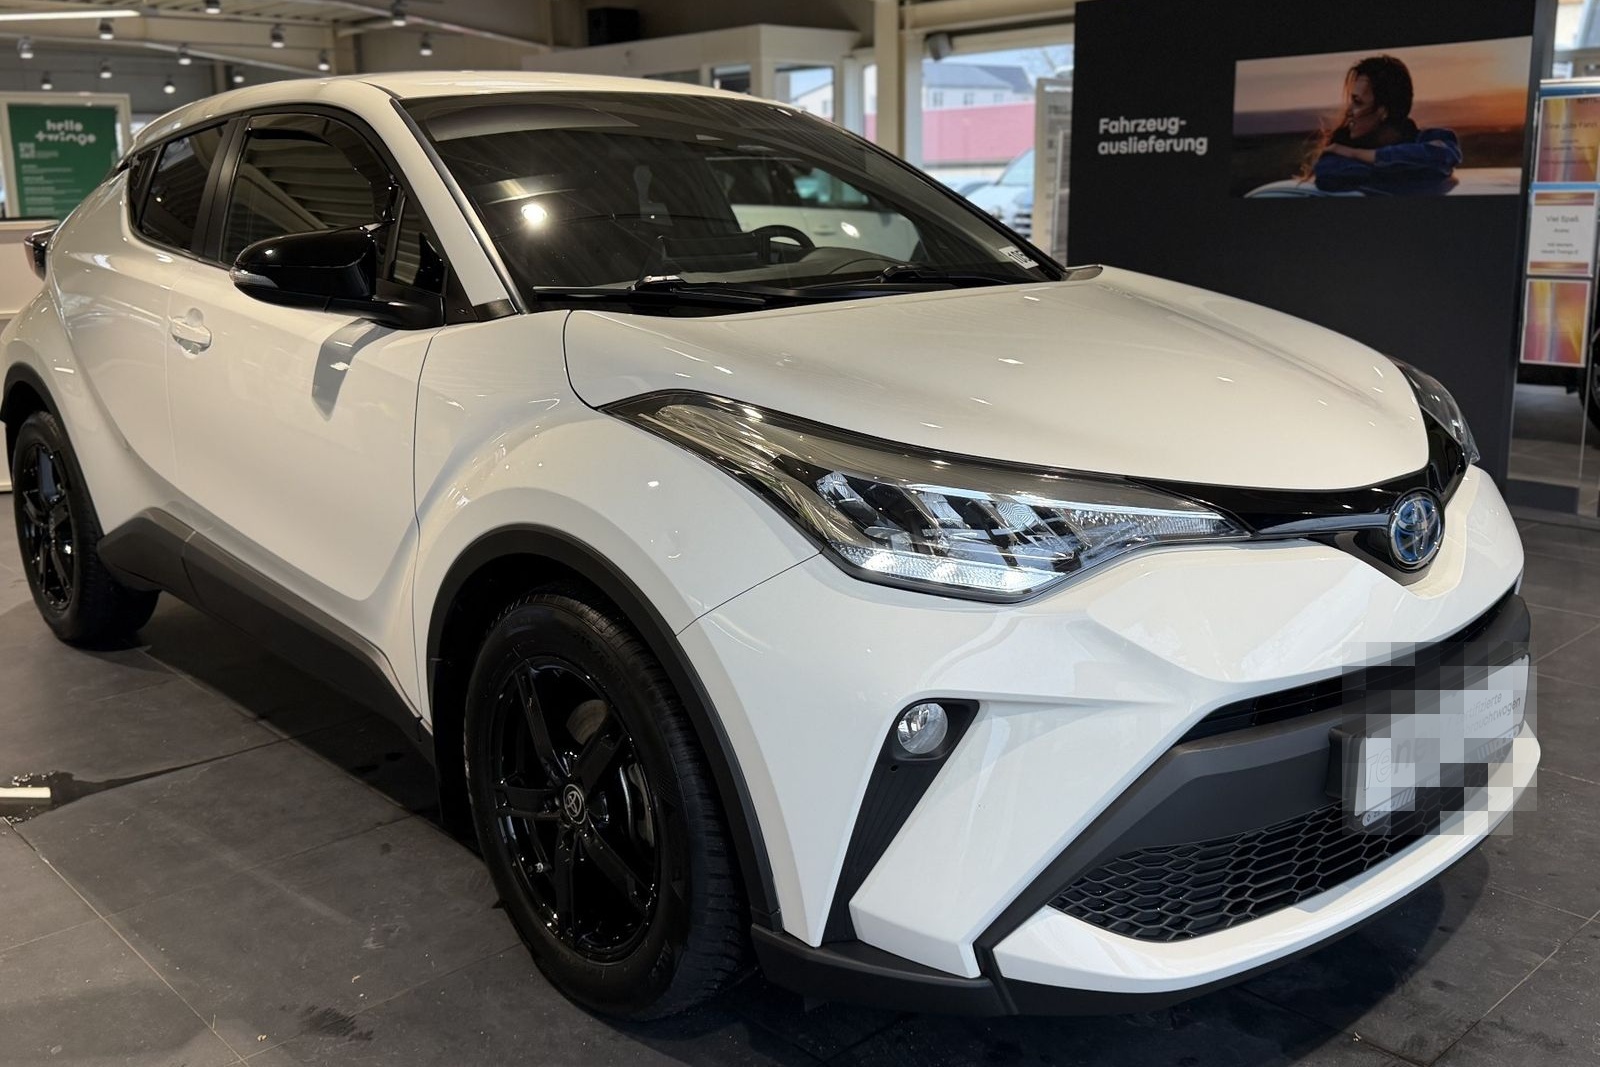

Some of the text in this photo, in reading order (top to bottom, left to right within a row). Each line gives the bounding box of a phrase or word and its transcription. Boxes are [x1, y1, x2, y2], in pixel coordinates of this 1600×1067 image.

[45, 119, 83, 132] hello
[1099, 116, 1187, 135] Fahrzeug-
[1098, 135, 1208, 156] auslieferung
